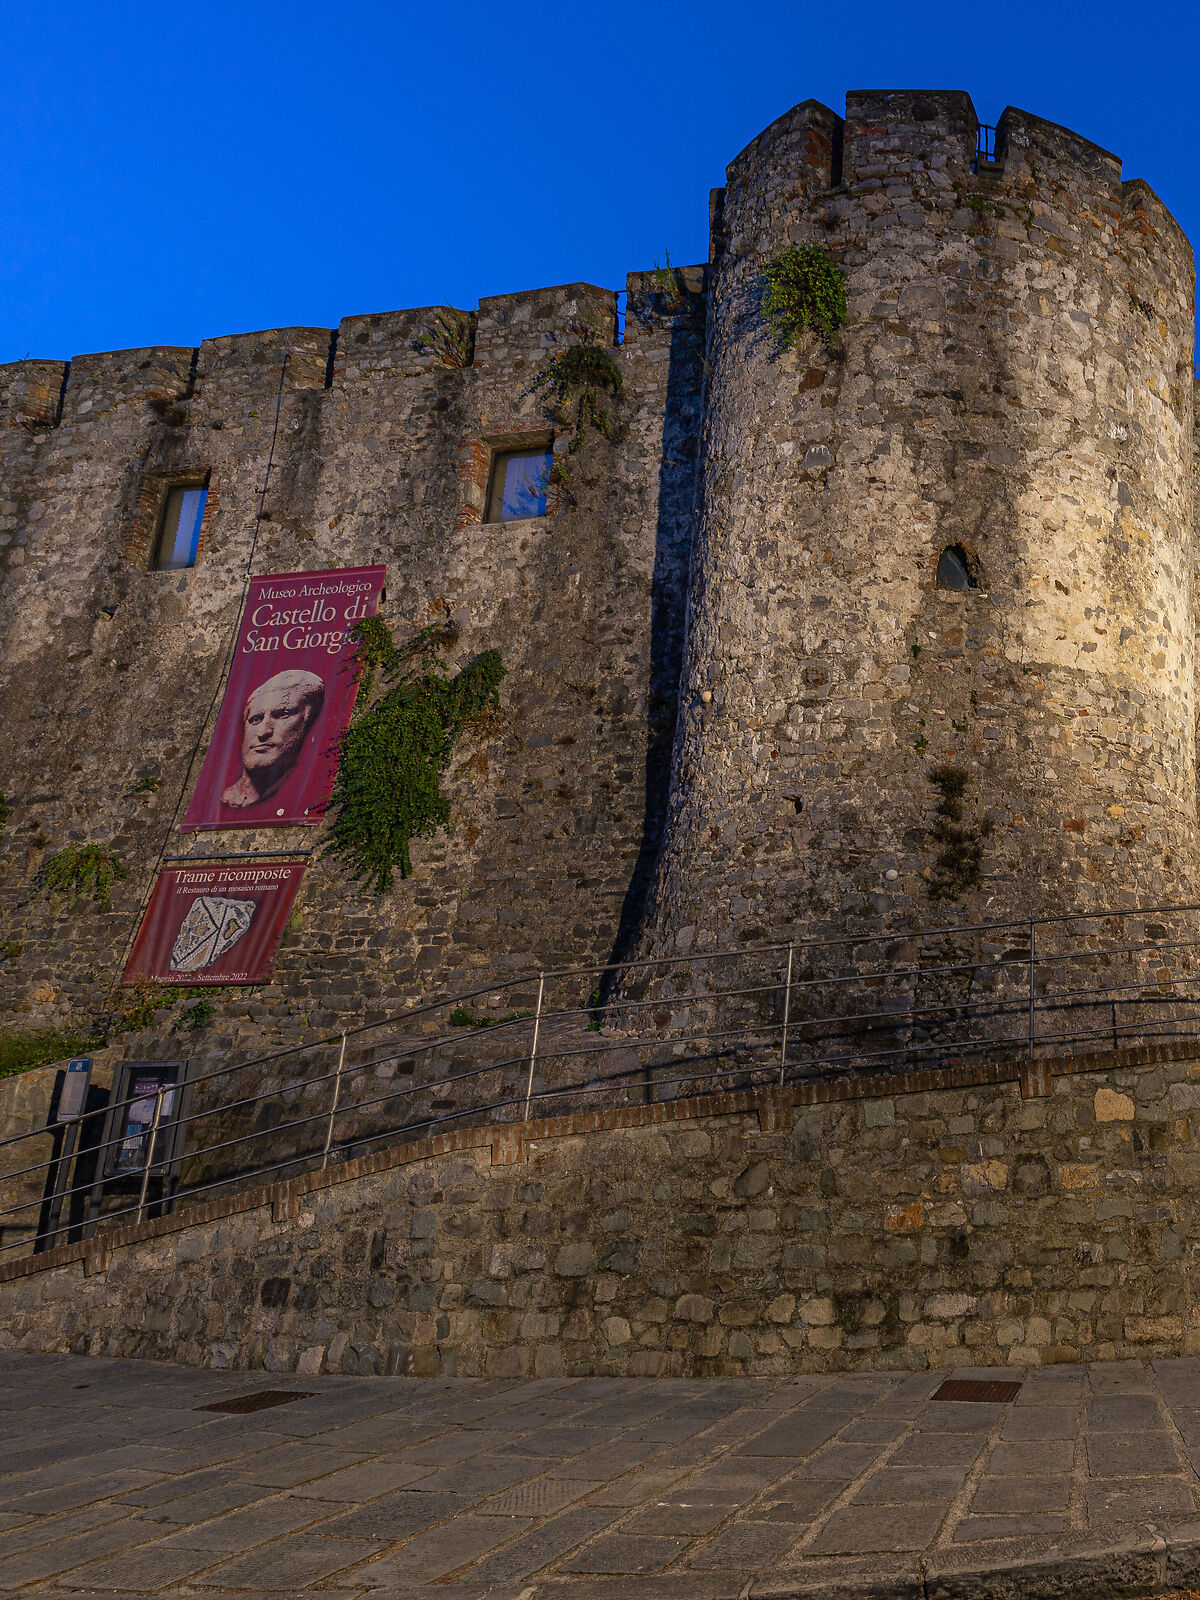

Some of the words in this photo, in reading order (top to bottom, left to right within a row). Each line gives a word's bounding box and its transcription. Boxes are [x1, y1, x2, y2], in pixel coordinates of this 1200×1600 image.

[258, 587, 296, 600] Museo
[298, 580, 372, 597] Archeologico
[251, 599, 337, 627] Castello
[344, 596, 369, 620] di
[242, 630, 280, 654] San
[175, 870, 215, 884] Trame
[217, 867, 292, 884] ricomposte
[176, 886, 182, 894] il
[182, 886, 210, 894] Restauro
[211, 885, 218, 893] di
[254, 884, 279, 892] romano
[196, 973, 230, 981] Settembre
[230, 972, 248, 981] 2022
